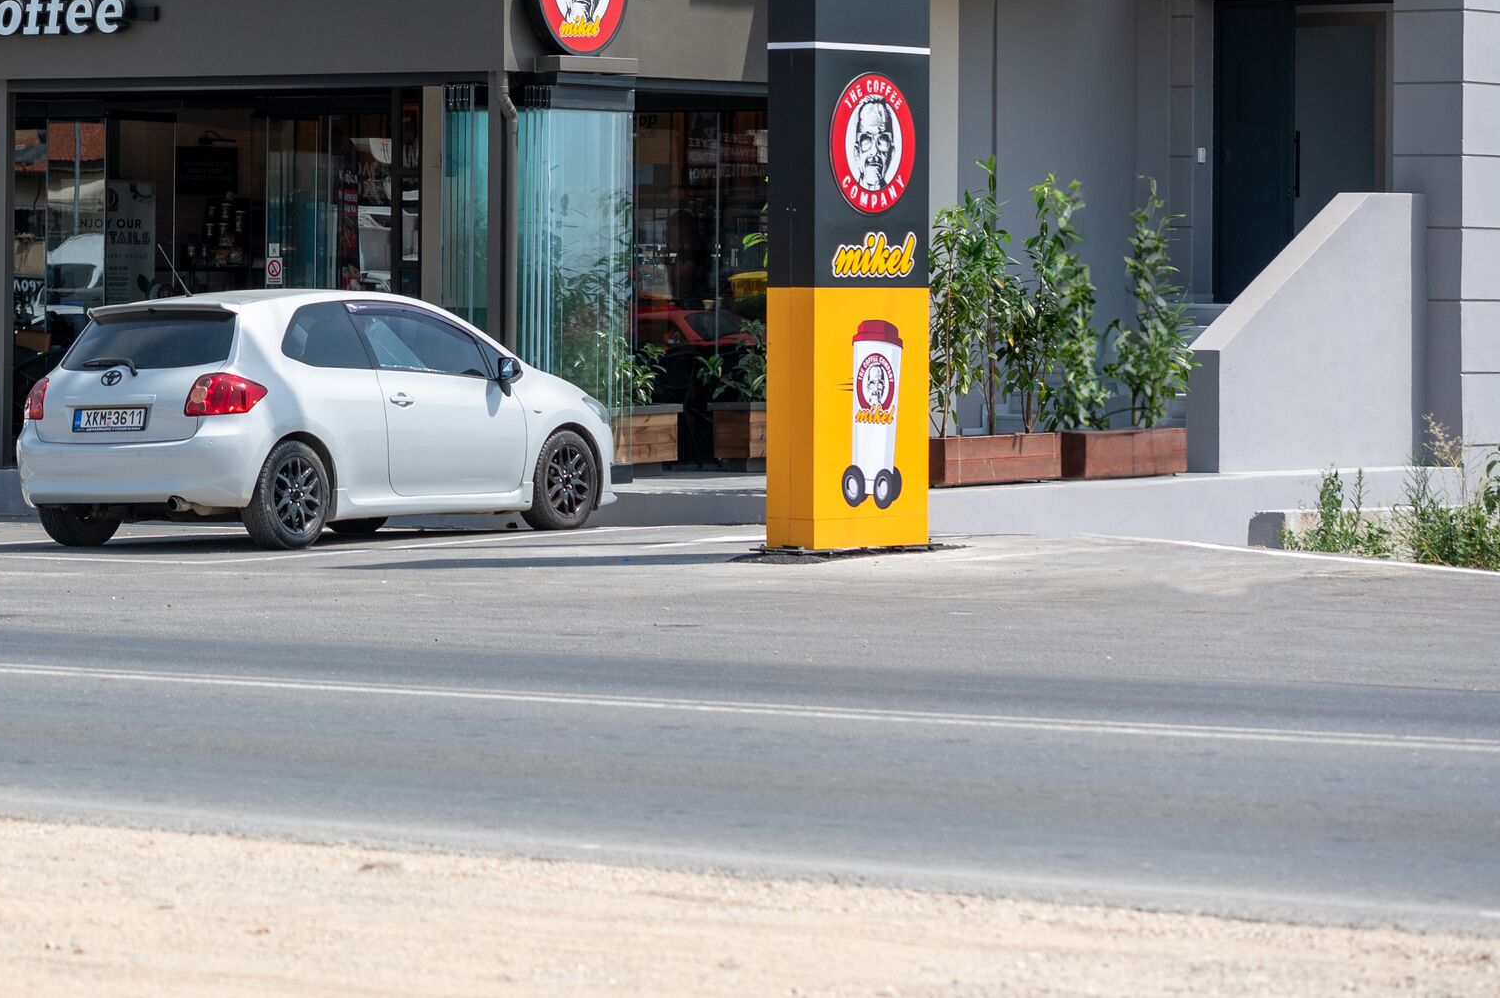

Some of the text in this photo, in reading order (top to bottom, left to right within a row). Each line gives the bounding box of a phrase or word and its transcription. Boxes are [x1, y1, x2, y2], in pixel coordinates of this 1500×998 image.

[560, 15, 600, 37] mikel
[844, 79, 903, 110] THE COFFEE
[842, 174, 905, 209] COMPANY
[79, 218, 142, 229] NJOY OUR
[834, 232, 916, 277] mikel
[855, 403, 895, 425] mikel
